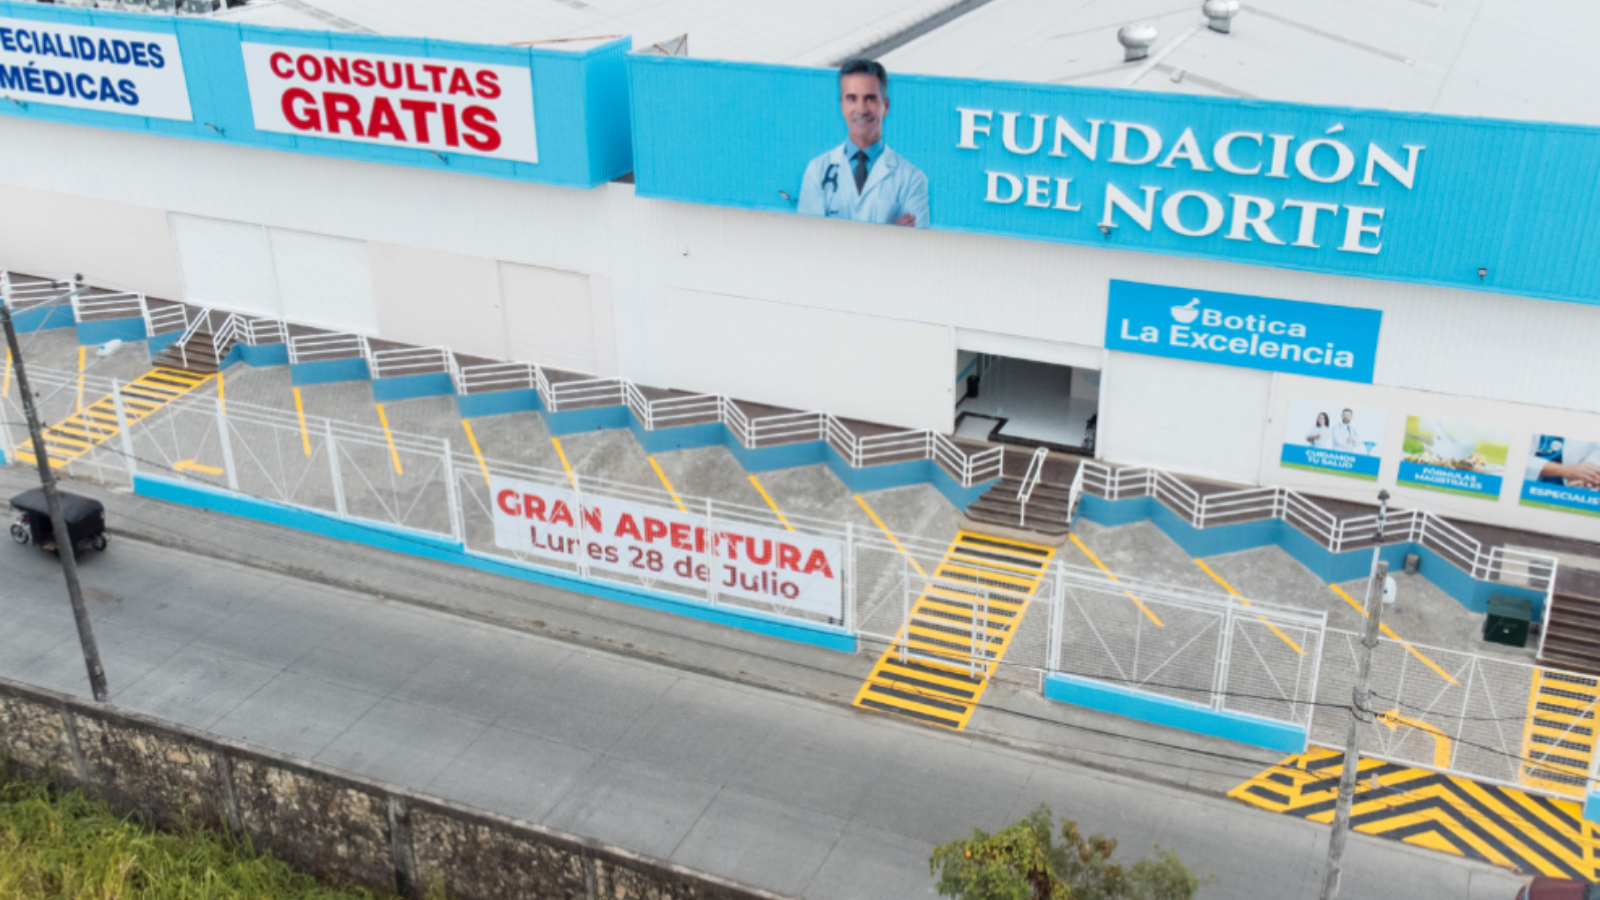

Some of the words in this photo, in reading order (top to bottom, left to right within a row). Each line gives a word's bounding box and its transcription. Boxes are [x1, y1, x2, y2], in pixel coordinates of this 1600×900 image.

[0, 61, 139, 106] MÉDICAS
[269, 51, 502, 99] CONSULTAS
[280, 87, 502, 152] GRATIS
[956, 107, 1426, 190] FUNDACIÓN
[984, 171, 1081, 211] DEL
[1100, 182, 1385, 255] NORTE
[1120, 318, 1159, 343] La
[1170, 324, 1355, 368] Excelencia
[1201, 308, 1306, 338] Botica
[1305, 449, 1356, 463] CUIDAMOS
[1308, 456, 1319, 464] TU
[1321, 457, 1353, 469] SALUD
[1423, 466, 1476, 482] FÓRMULAS
[1414, 473, 1483, 490] MAGISTRALES
[497, 489, 602, 533] GRAN
[614, 512, 834, 579] APERTURA
[628, 546, 664, 572] 28
[674, 555, 711, 582] de
[722, 564, 799, 599] Julio
